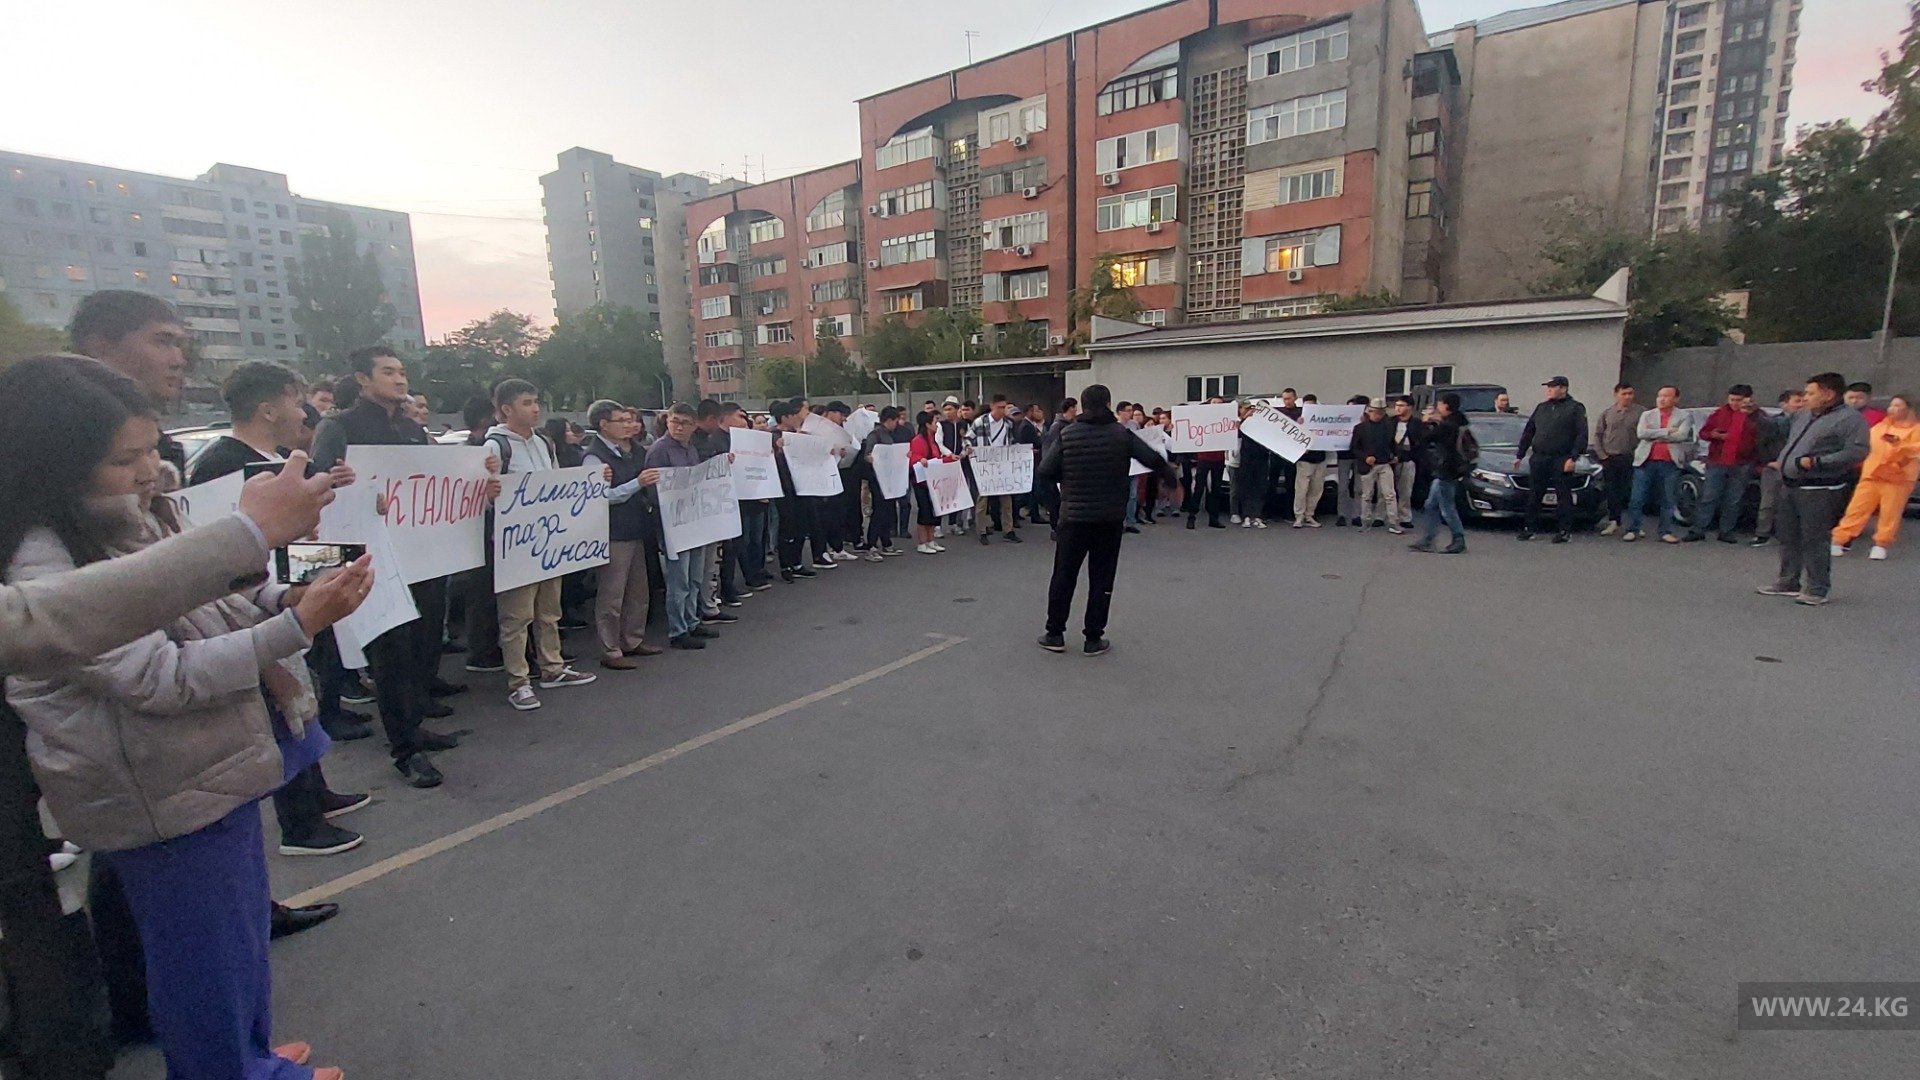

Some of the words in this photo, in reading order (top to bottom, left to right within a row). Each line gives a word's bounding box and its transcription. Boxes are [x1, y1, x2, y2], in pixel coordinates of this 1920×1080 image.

[370, 473, 488, 527] КТАЛСЫН
[501, 471, 610, 517] Алмазбек
[502, 513, 568, 560] таза
[541, 540, 610, 571] инсан
